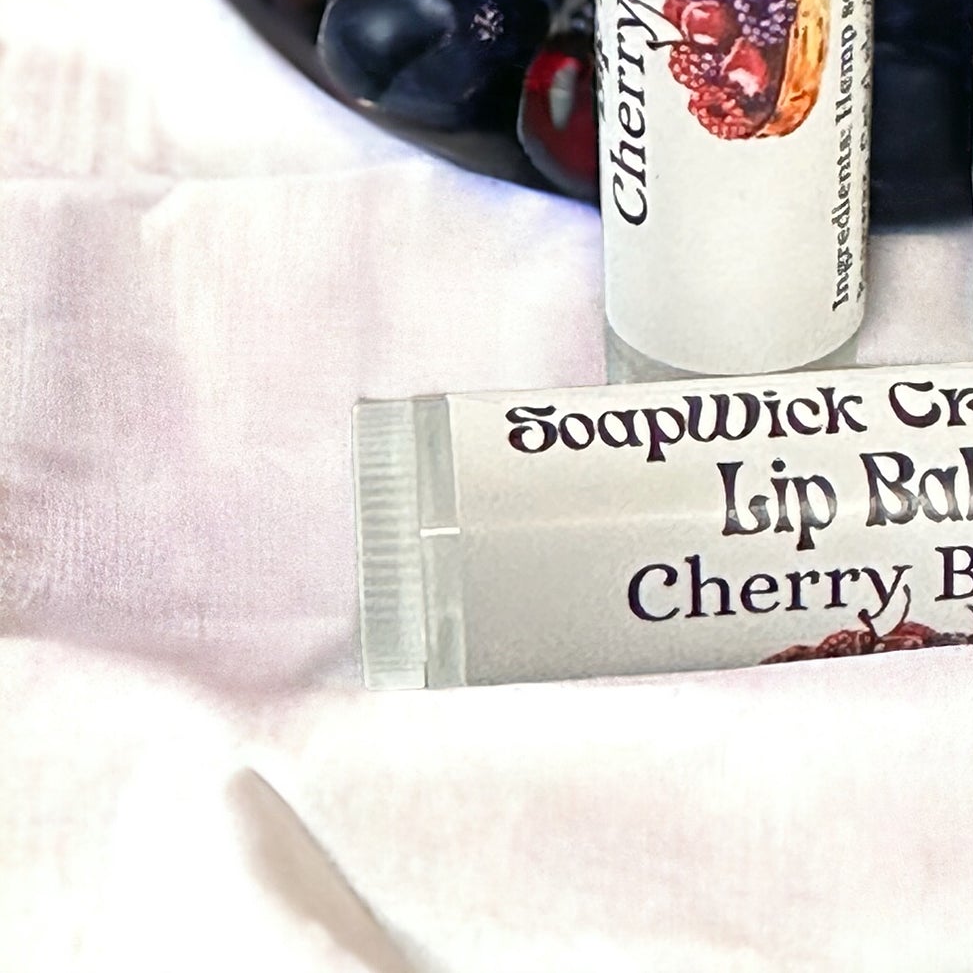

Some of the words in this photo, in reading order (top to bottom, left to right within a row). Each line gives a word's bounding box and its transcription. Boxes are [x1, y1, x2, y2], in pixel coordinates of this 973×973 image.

[835, 24, 858, 126] Hemp
[831, 125, 854, 313] Ingredients:
[505, 386, 869, 463] SoapWick
[716, 457, 838, 552] Lip
[627, 554, 912, 622] Cherry
